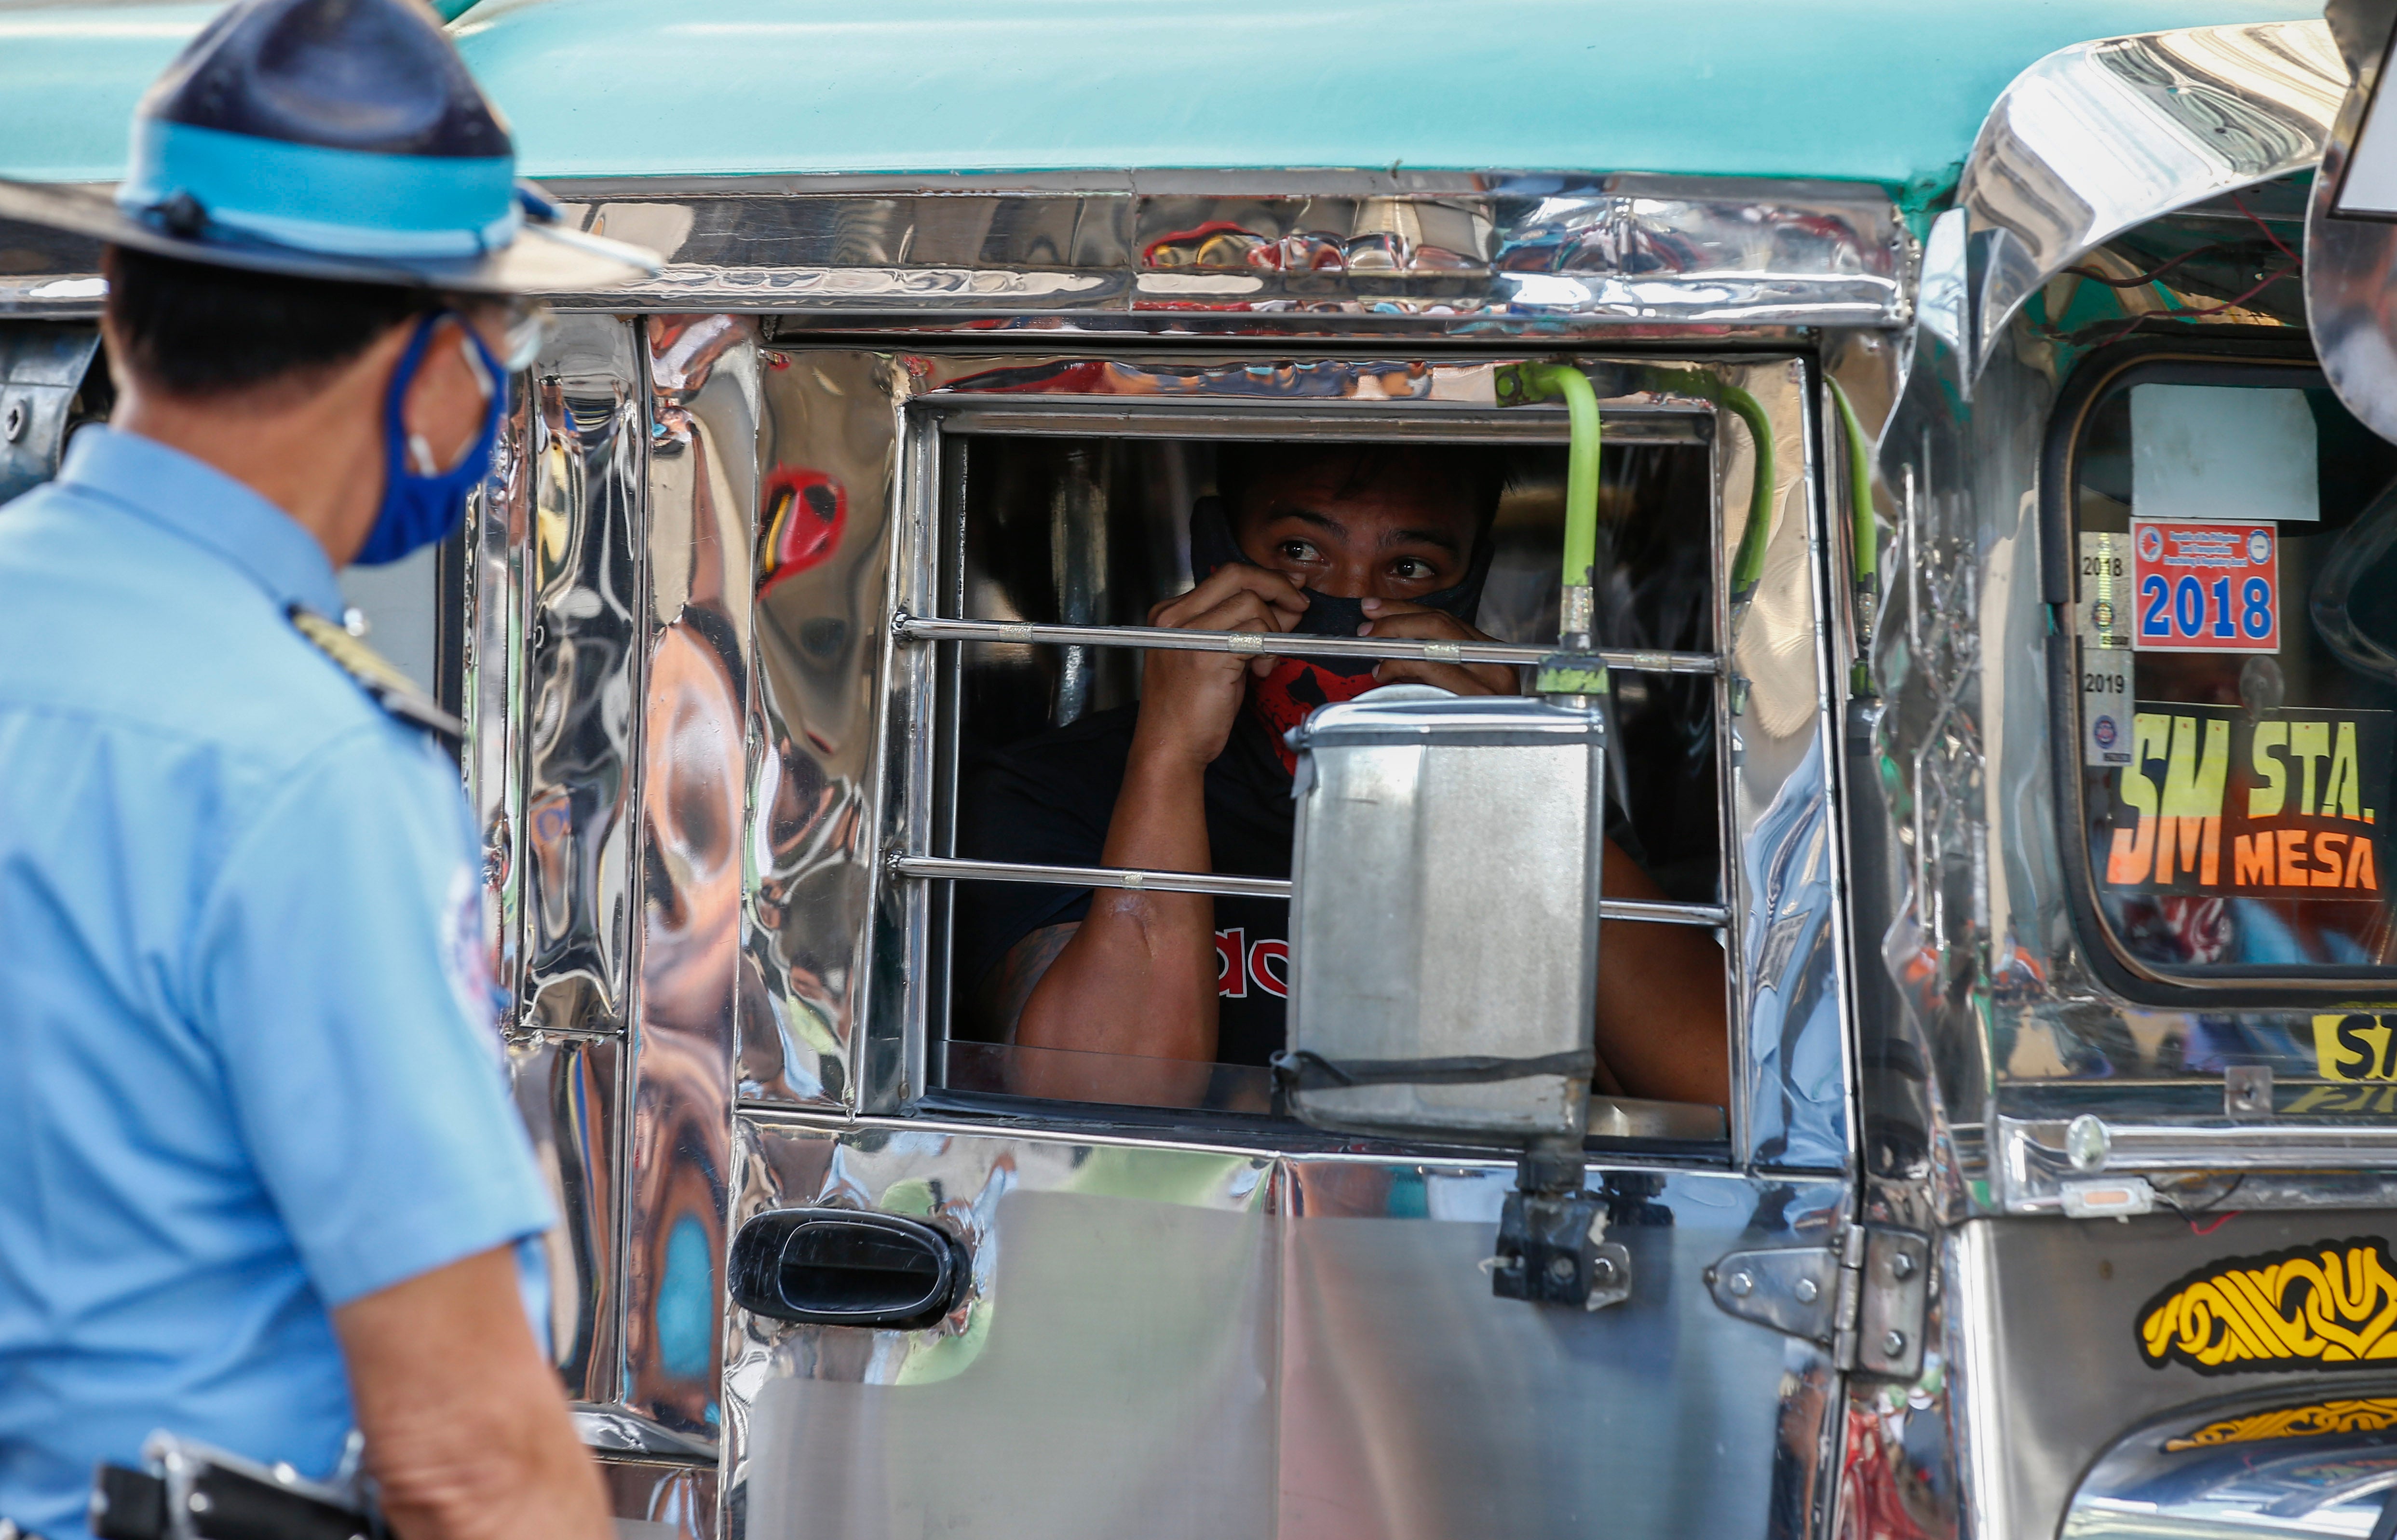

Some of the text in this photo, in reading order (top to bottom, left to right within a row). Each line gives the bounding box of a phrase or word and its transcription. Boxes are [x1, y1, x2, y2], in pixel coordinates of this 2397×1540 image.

[2141, 574, 2273, 639] 2018
[2086, 674, 2124, 693] 2019
[2106, 712, 2230, 885] SM
[2248, 721, 2375, 824] STA.
[2234, 829, 2378, 891] MESA
